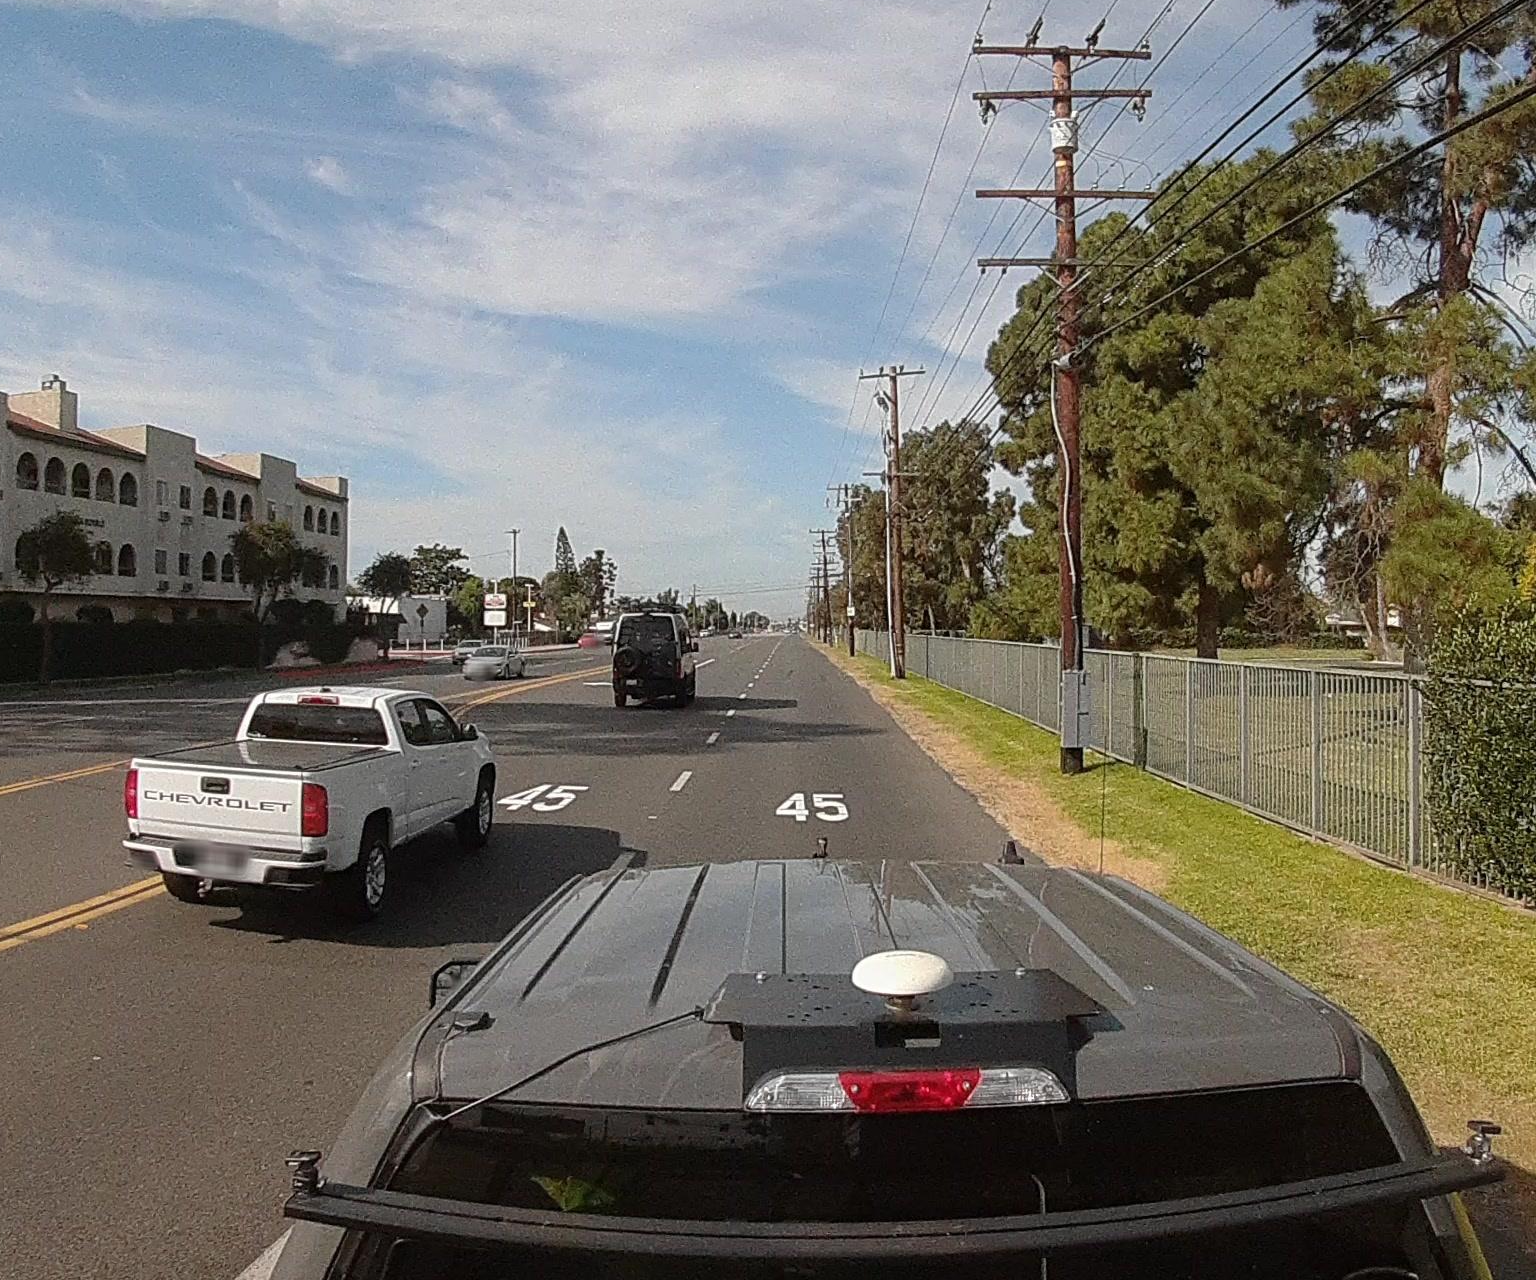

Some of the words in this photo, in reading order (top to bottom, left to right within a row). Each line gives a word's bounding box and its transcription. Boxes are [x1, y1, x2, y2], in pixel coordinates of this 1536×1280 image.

[144, 790, 293, 813] CHEVROLET
[496, 784, 590, 812] 45
[775, 792, 850, 822] 45
